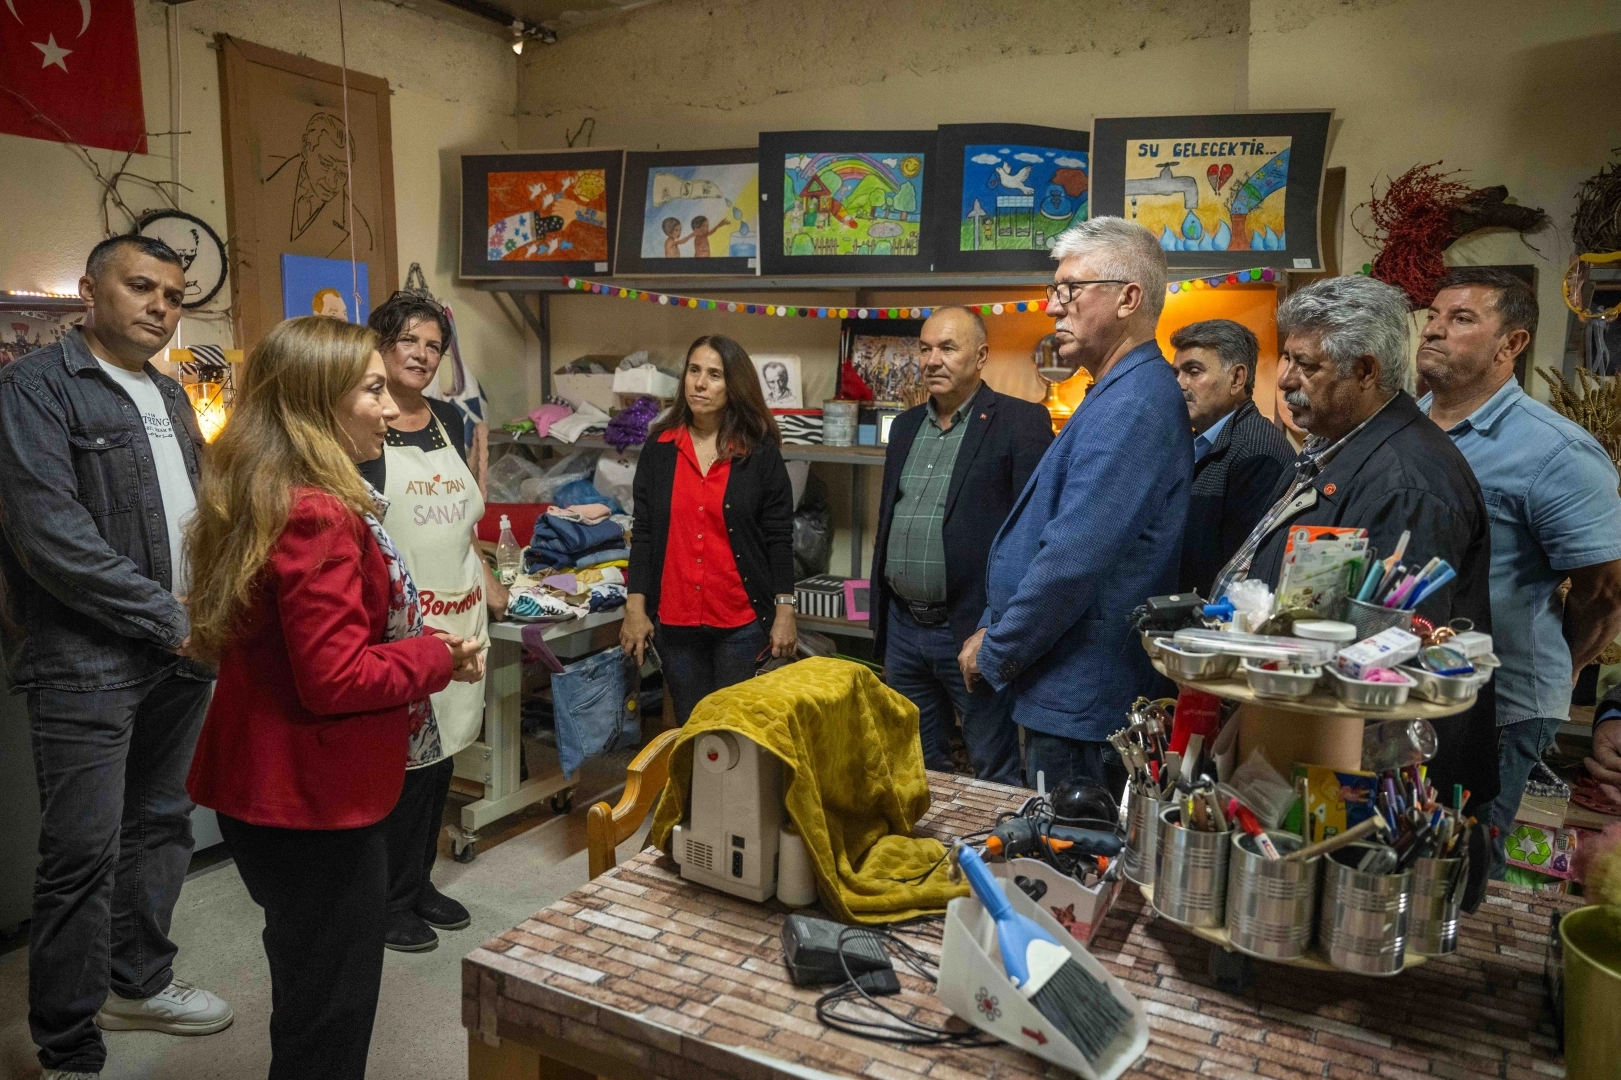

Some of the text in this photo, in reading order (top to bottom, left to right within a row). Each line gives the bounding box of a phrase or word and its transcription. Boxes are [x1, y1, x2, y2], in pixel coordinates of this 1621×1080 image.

[1138, 143, 1159, 157] SU
[405, 477, 466, 496] ATIK TAN
[413, 499, 469, 526] SANAT
